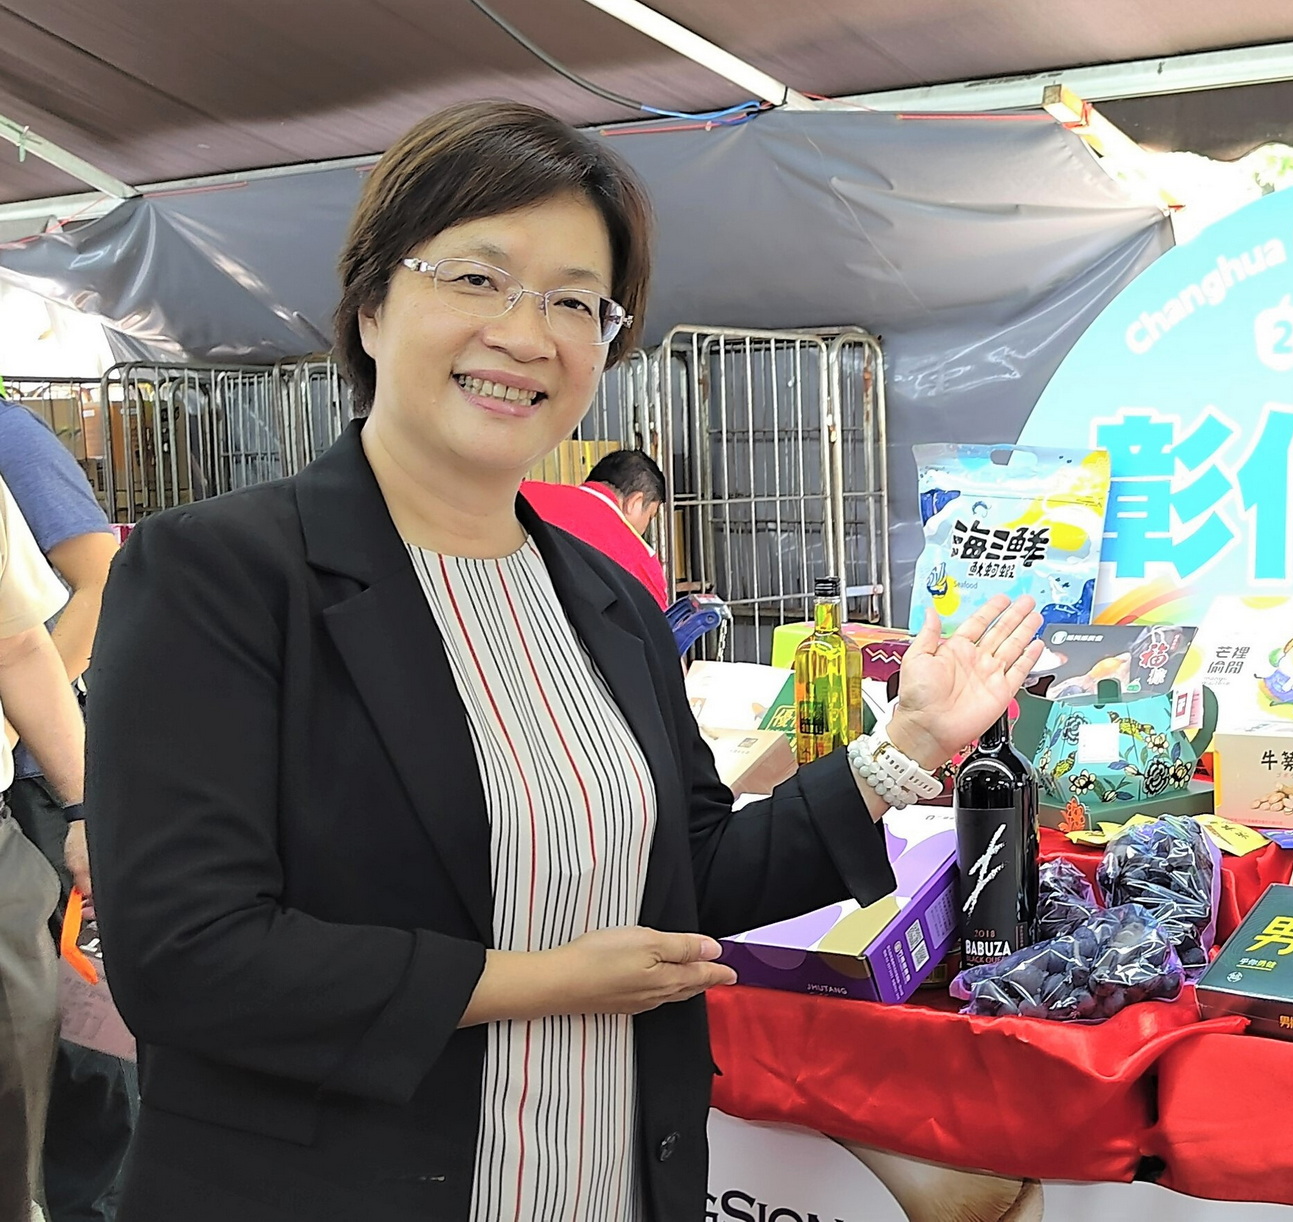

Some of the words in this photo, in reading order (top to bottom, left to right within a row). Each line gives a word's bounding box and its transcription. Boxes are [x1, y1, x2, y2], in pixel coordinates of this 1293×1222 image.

[1126, 236, 1286, 355] Changhua
[974, 929, 996, 938] 2018
[965, 939, 1012, 957] BABUZA
[806, 983, 848, 995] JHUTANG
